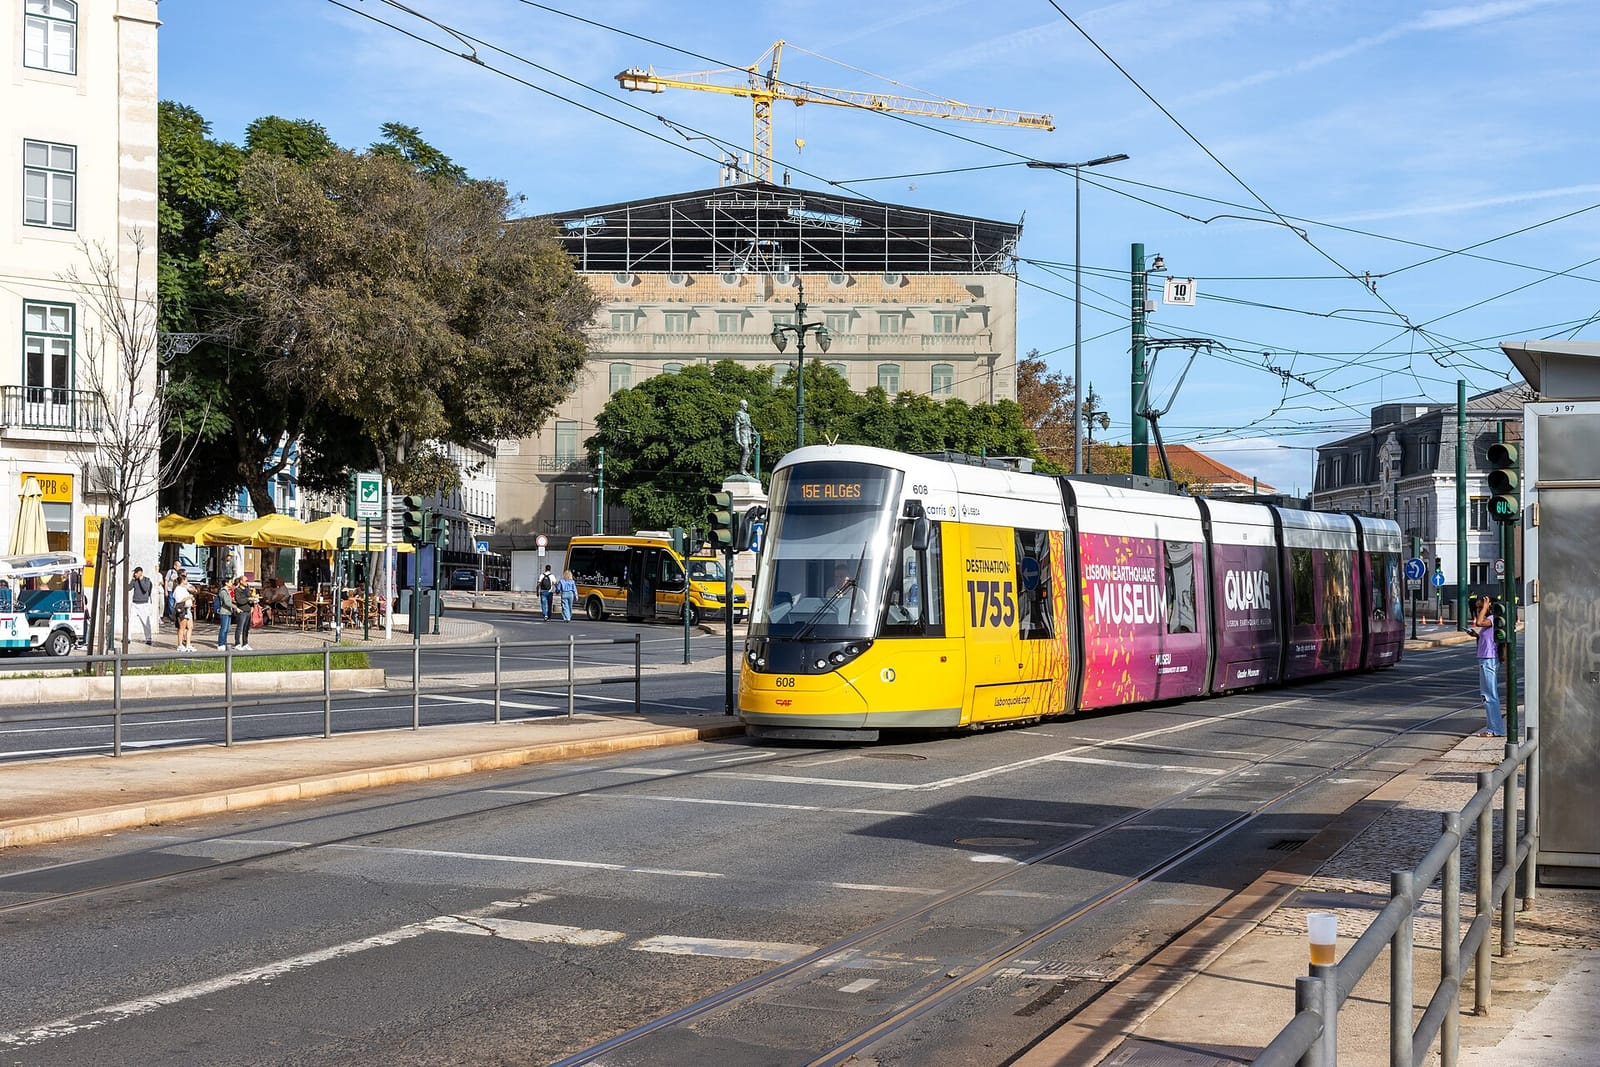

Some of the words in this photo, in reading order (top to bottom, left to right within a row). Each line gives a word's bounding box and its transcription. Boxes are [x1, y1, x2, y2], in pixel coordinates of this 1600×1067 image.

[1174, 284, 1187, 296] 10
[801, 484, 821, 498] 15E
[912, 484, 929, 495] 608
[1496, 501, 1513, 514] BUS
[1085, 564, 1111, 580] LISBON
[1113, 565, 1156, 583] EARTHQUAKE
[1225, 569, 1271, 612] QUAKE
[967, 580, 1015, 628] 1755
[1093, 582, 1168, 625] MUSEUM
[776, 677, 795, 688] 608
